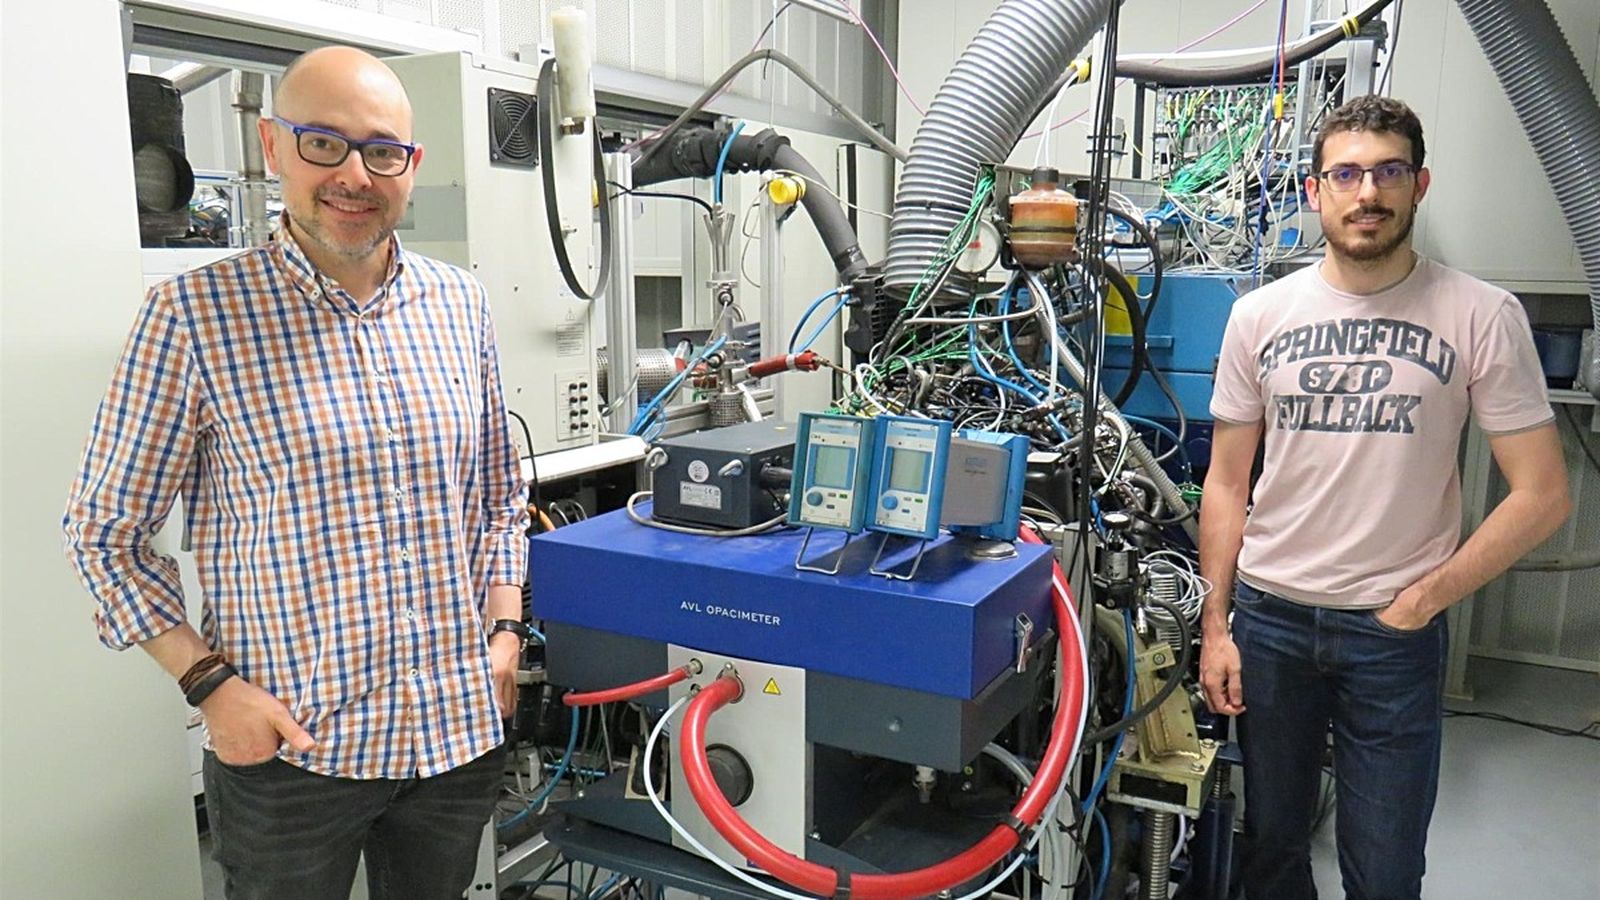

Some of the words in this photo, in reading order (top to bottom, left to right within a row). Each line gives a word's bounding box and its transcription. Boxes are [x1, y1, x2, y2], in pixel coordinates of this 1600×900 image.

[1259, 318, 1456, 385] SPRINGFIELD
[1273, 394, 1422, 434] FULLBACK
[680, 601, 702, 612] AVL
[706, 605, 781, 626] OPACIMETER
